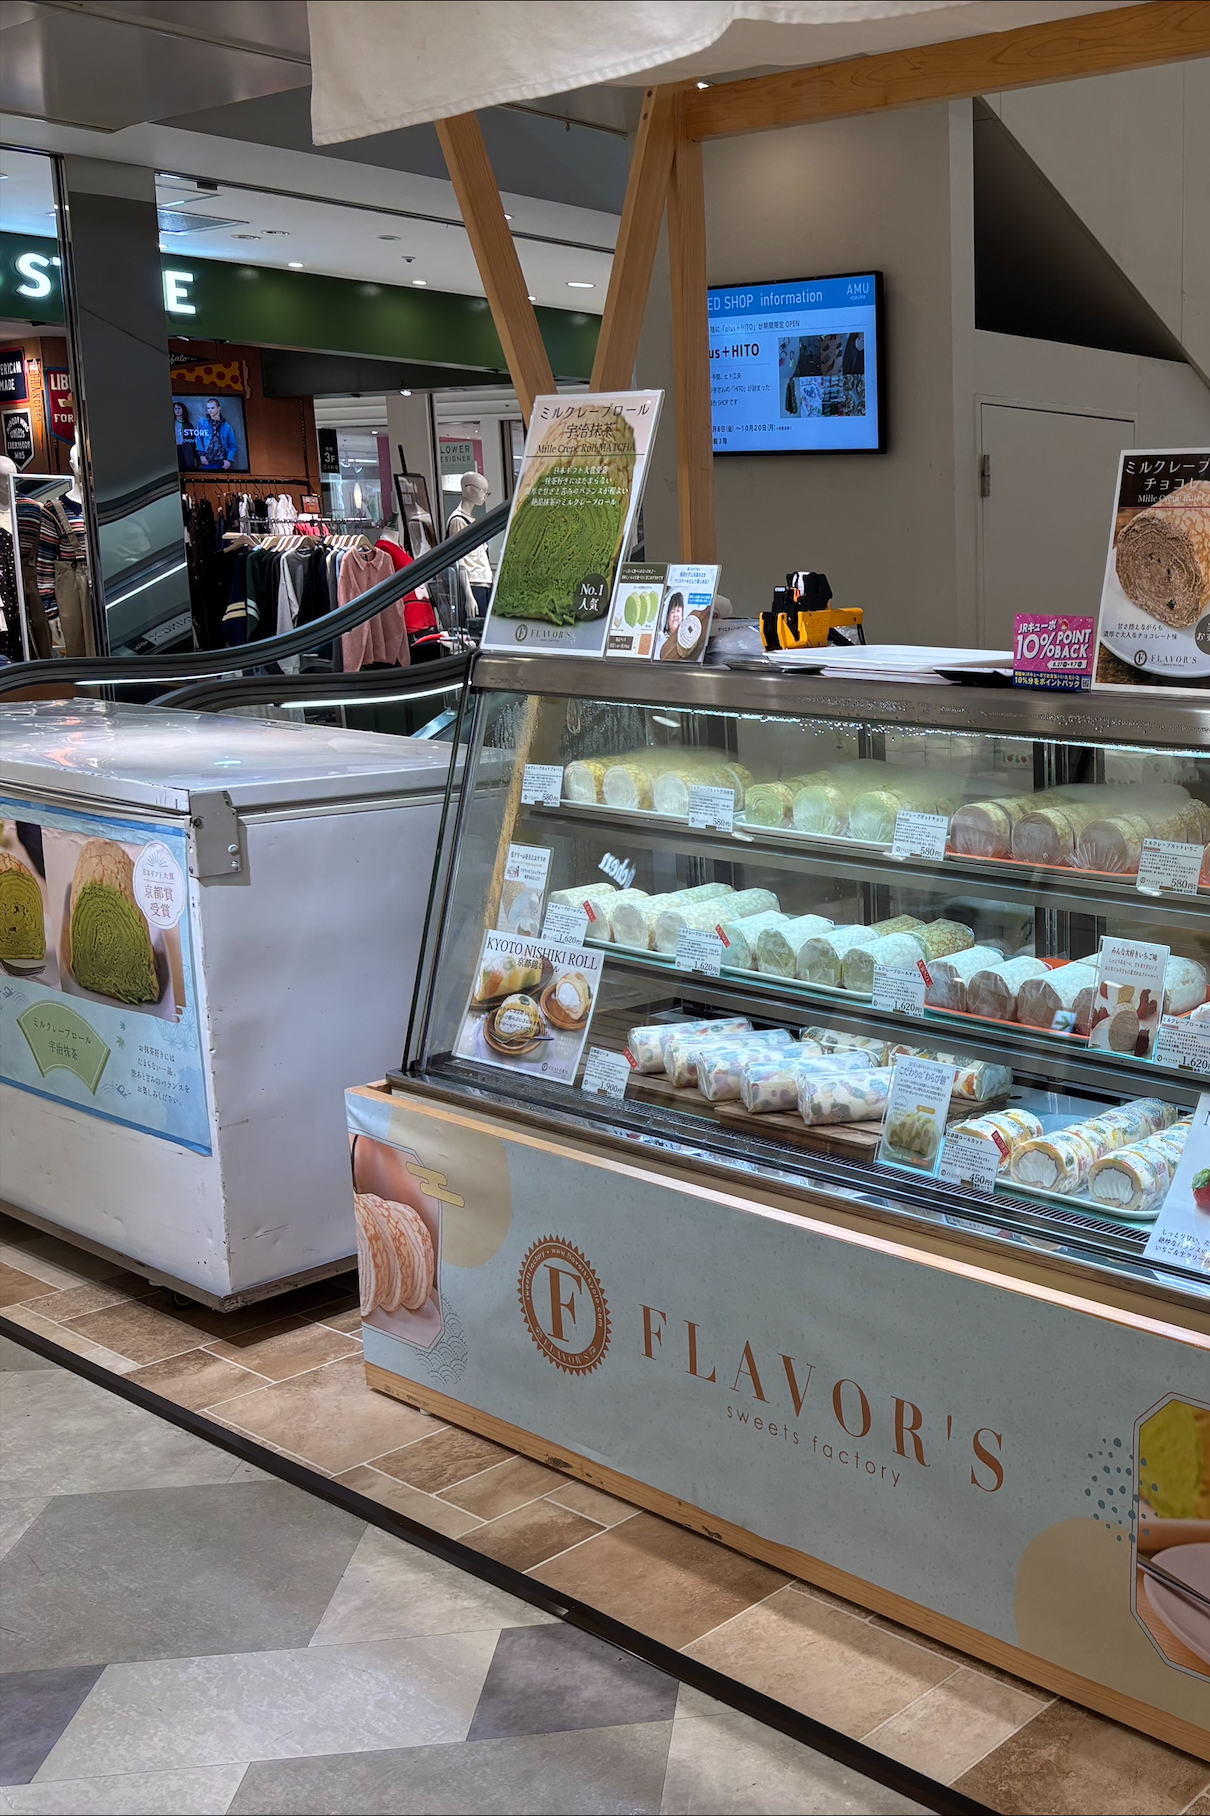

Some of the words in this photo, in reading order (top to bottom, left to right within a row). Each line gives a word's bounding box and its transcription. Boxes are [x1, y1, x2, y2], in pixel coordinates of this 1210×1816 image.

[724, 294, 754, 310] SHOP
[760, 289, 823, 307] information
[846, 282, 869, 295] AMU
[540, 403, 650, 420] ミルクレープロール
[183, 428, 210, 437] STORE
[565, 421, 616, 439] 宇治抹茶
[536, 444, 557, 454] Mille
[557, 444, 581, 455] Crepe
[599, 443, 636, 453] MATCHA
[579, 583, 604, 596] No.1
[578, 599, 600, 612] 人気
[1016, 631, 1056, 660] 10%
[1056, 628, 1092, 645] POINT
[1054, 643, 1089, 659] BACK
[1150, 654, 1198, 665] FLAVOR'S
[144, 884, 174, 902] 京都賞
[150, 902, 171, 919] 受賞
[486, 936, 523, 955] KYOTO
[522, 944, 567, 965] NISHIKI
[567, 952, 598, 971] ROLL
[48, 1039, 79, 1061] 宇治抹茶
[638, 1303, 1007, 1493] FLAVOR'S
[726, 1403, 801, 1446] sweets
[811, 1434, 902, 1488] factory
